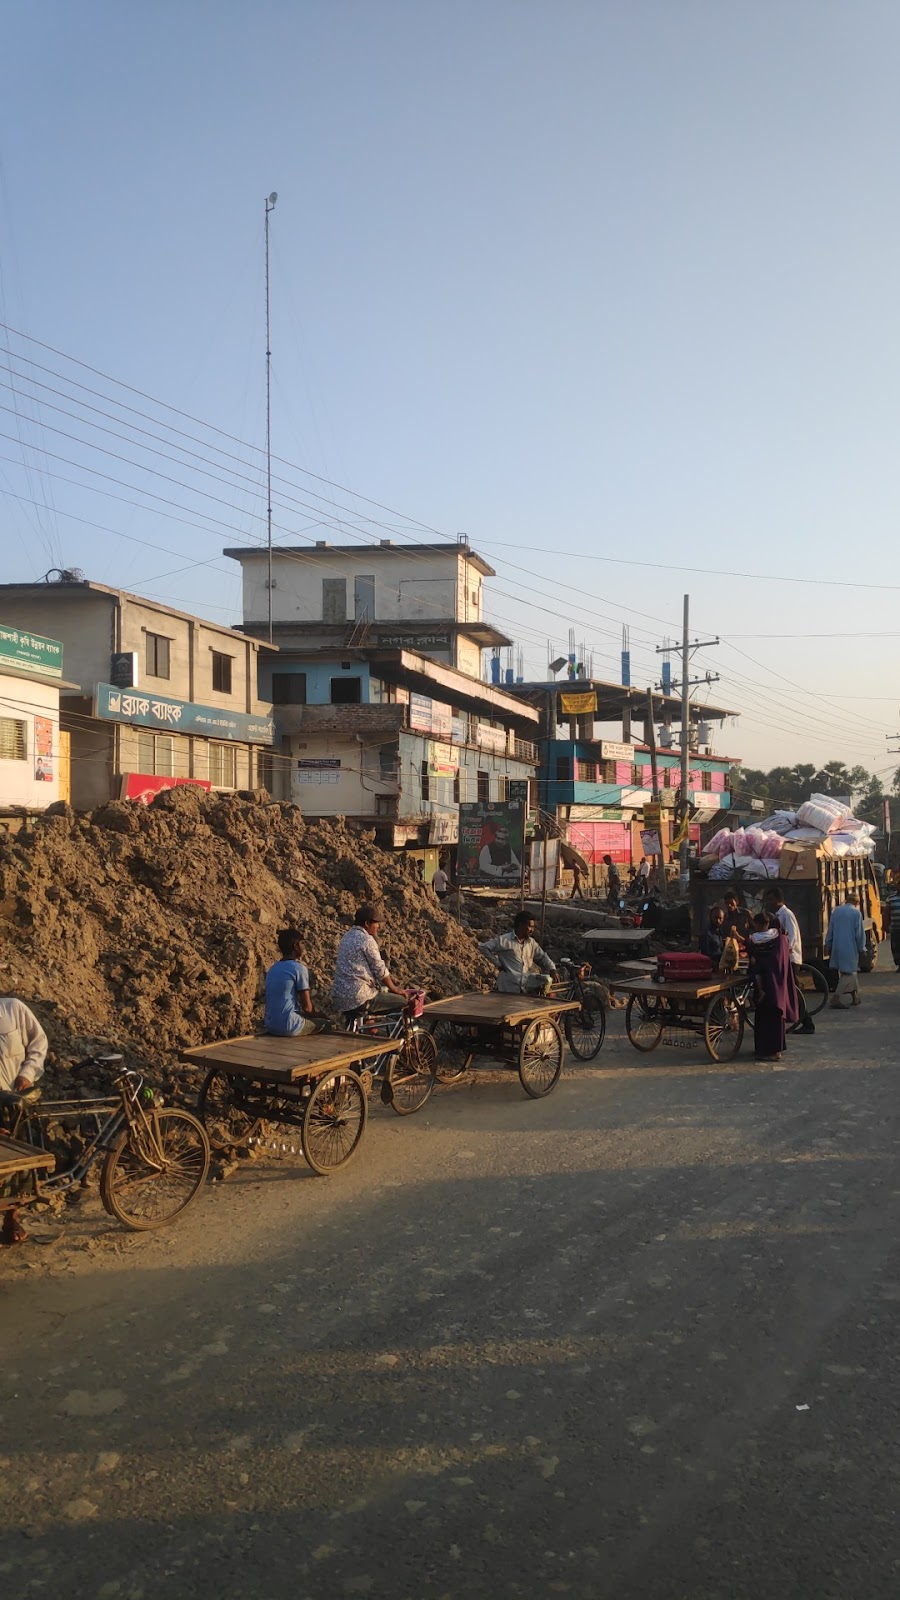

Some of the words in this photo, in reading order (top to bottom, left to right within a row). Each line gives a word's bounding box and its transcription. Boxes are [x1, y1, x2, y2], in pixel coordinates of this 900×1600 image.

[381, 636, 414, 645] নগর
[416, 635, 449, 645] ক্লাব
[46, 643, 60, 655] ব্যাংক
[121, 694, 150, 717] ব্র্যাক
[151, 700, 182, 724] ব্যাংক
